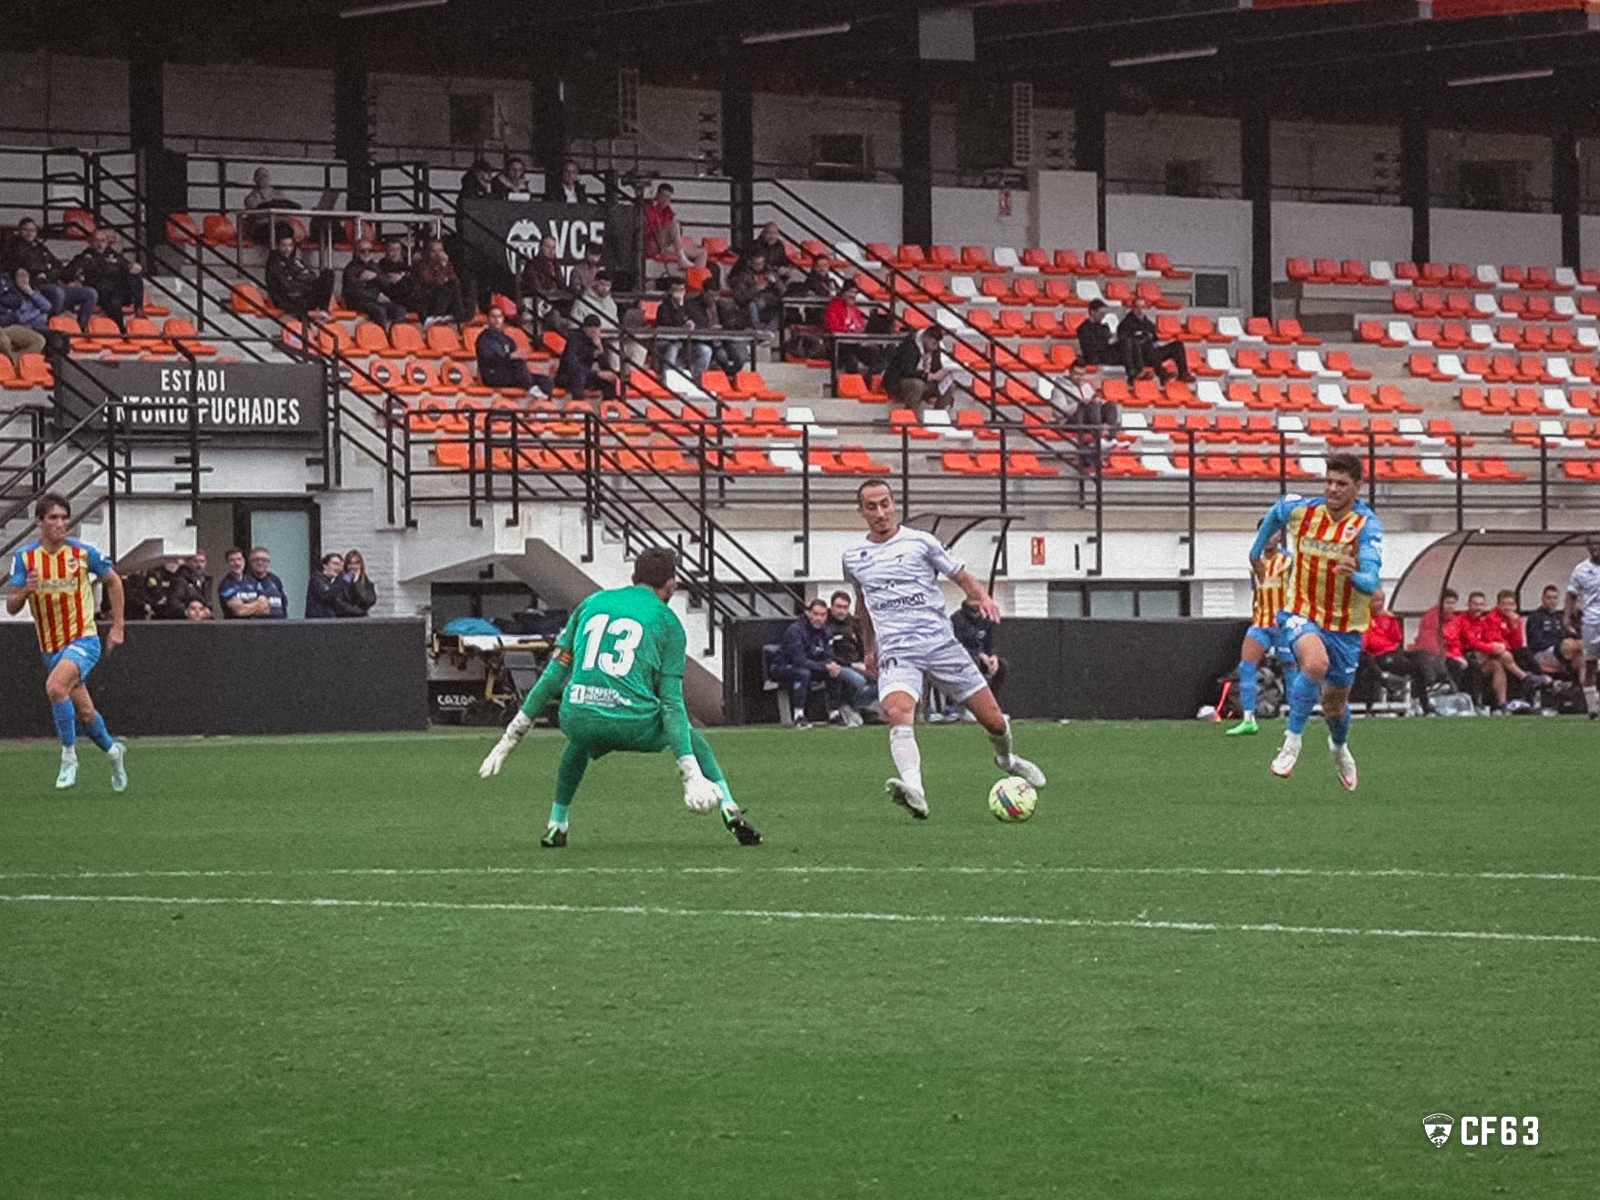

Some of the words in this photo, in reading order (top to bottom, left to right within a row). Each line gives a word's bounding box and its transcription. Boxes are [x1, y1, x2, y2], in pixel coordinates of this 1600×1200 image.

[160, 369, 227, 392] ESTADI
[197, 397, 301, 426] PUCHADES
[581, 613, 644, 677] 13
